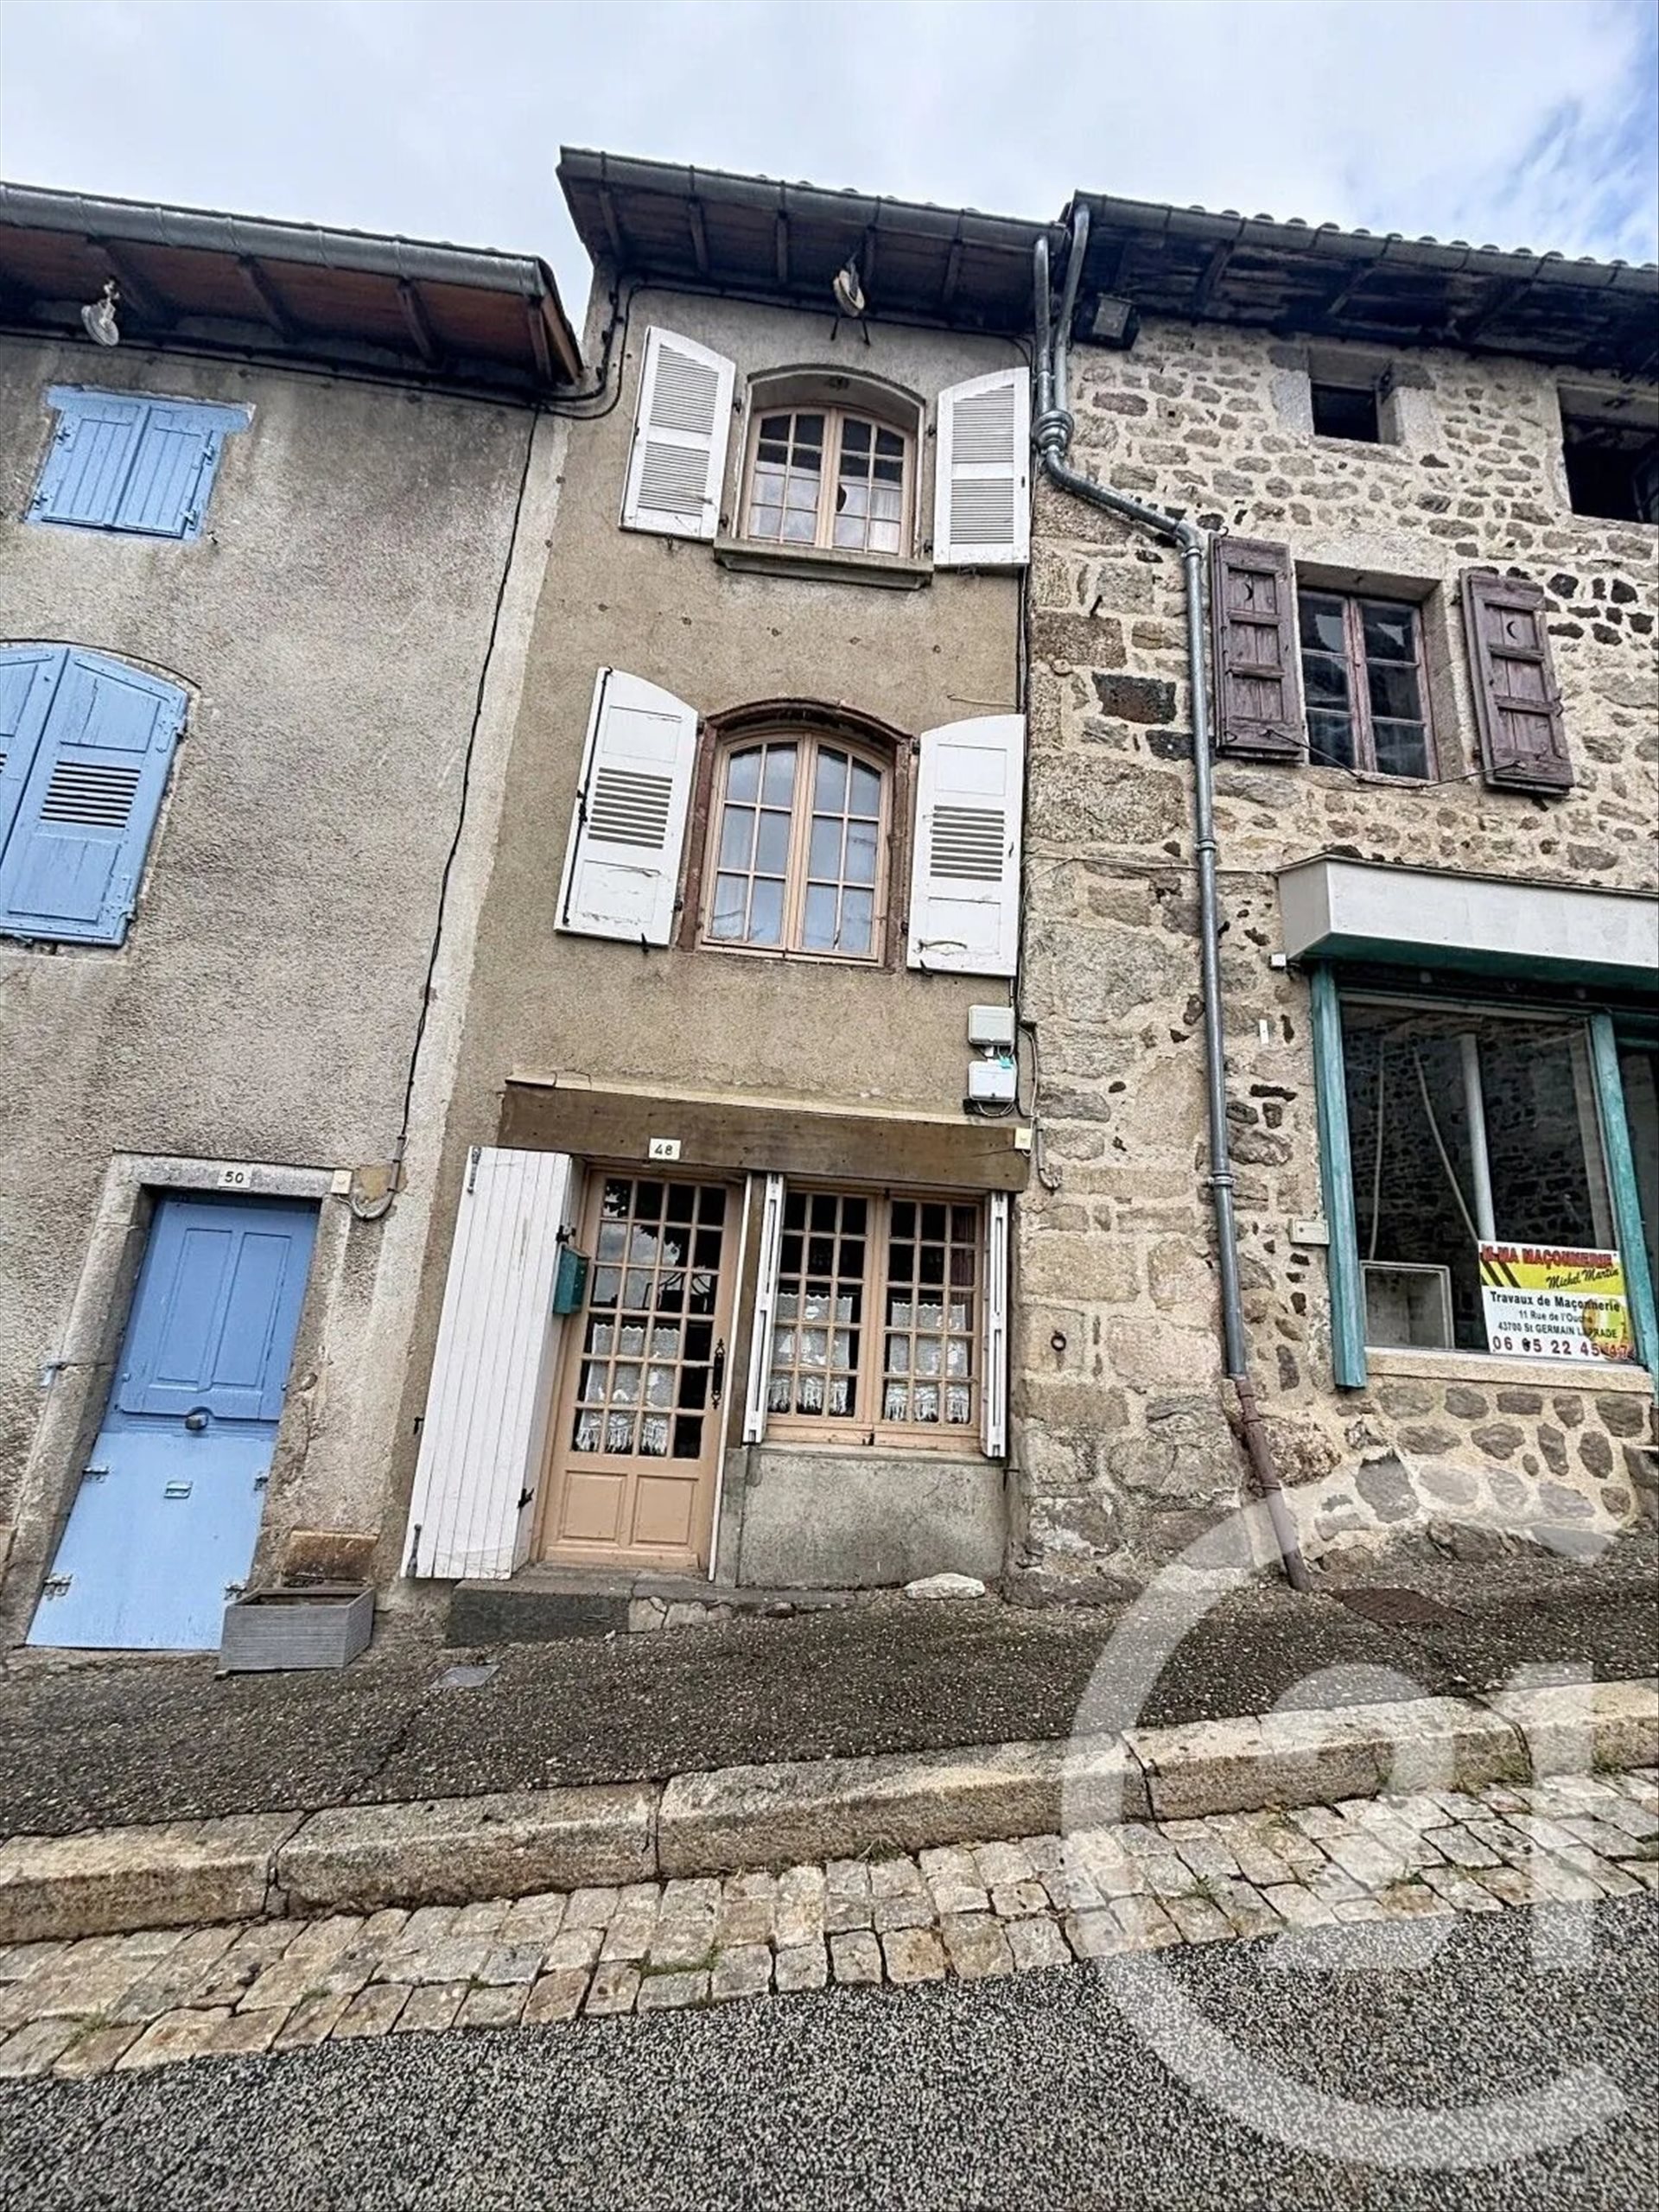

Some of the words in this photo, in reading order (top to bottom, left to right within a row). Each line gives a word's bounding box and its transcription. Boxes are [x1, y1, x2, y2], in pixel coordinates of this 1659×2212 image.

[654, 1143, 673, 1156] 48
[224, 1171, 245, 1184] 50
[1546, 1273, 1581, 1289] Michel
[1581, 1268, 1619, 1281] Martin
[1490, 1291, 1534, 1306] Travaux
[1537, 1294, 1551, 1307] de
[1554, 1297, 1620, 1313] Maçonnerie
[1519, 1310, 1528, 1319] 11
[1530, 1310, 1547, 1321] Rue
[1549, 1313, 1560, 1322] de
[1561, 1313, 1594, 1325] l'Ouce
[1497, 1321, 1522, 1332] 43700
[1524, 1323, 1534, 1333] St
[1536, 1324, 1574, 1336] GERMAIN
[1493, 1336, 1513, 1351] 06
[1550, 1340, 1572, 1355] 22
[1580, 1342, 1601, 1357] 45
